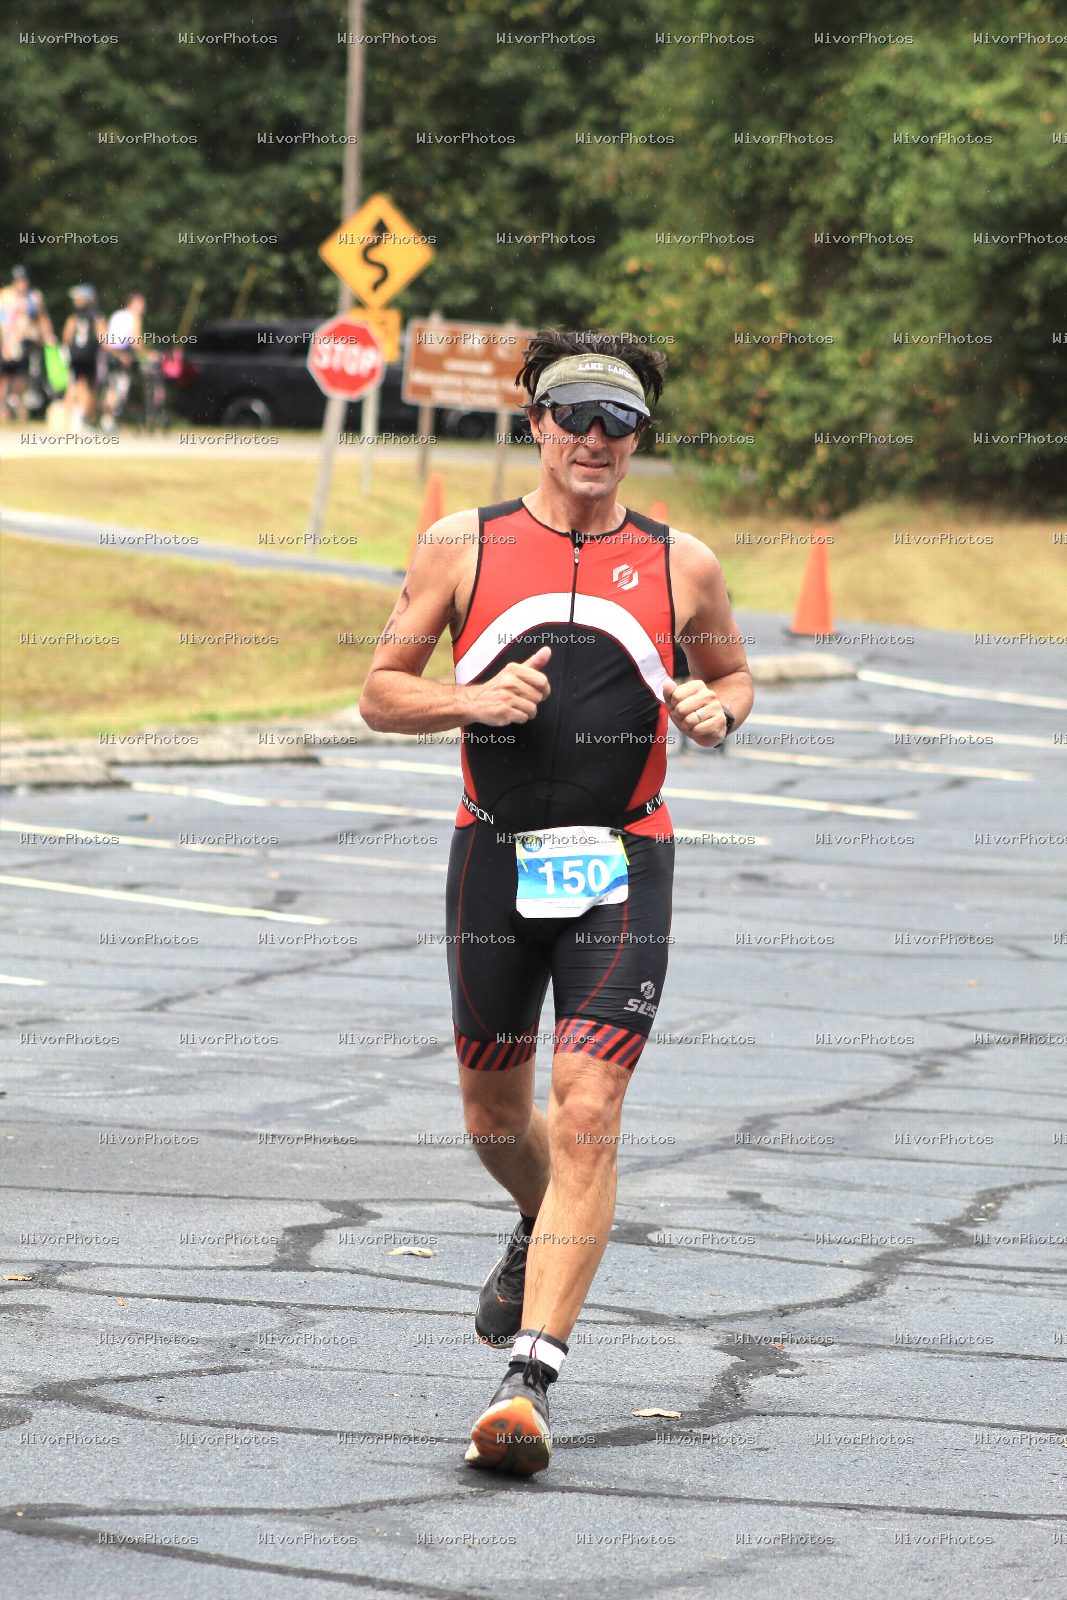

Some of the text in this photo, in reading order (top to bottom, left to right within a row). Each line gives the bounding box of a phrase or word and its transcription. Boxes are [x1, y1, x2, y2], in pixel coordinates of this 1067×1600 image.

[313, 341, 378, 378] STOP
[576, 361, 604, 371] LAKE
[537, 858, 611, 895] 150
